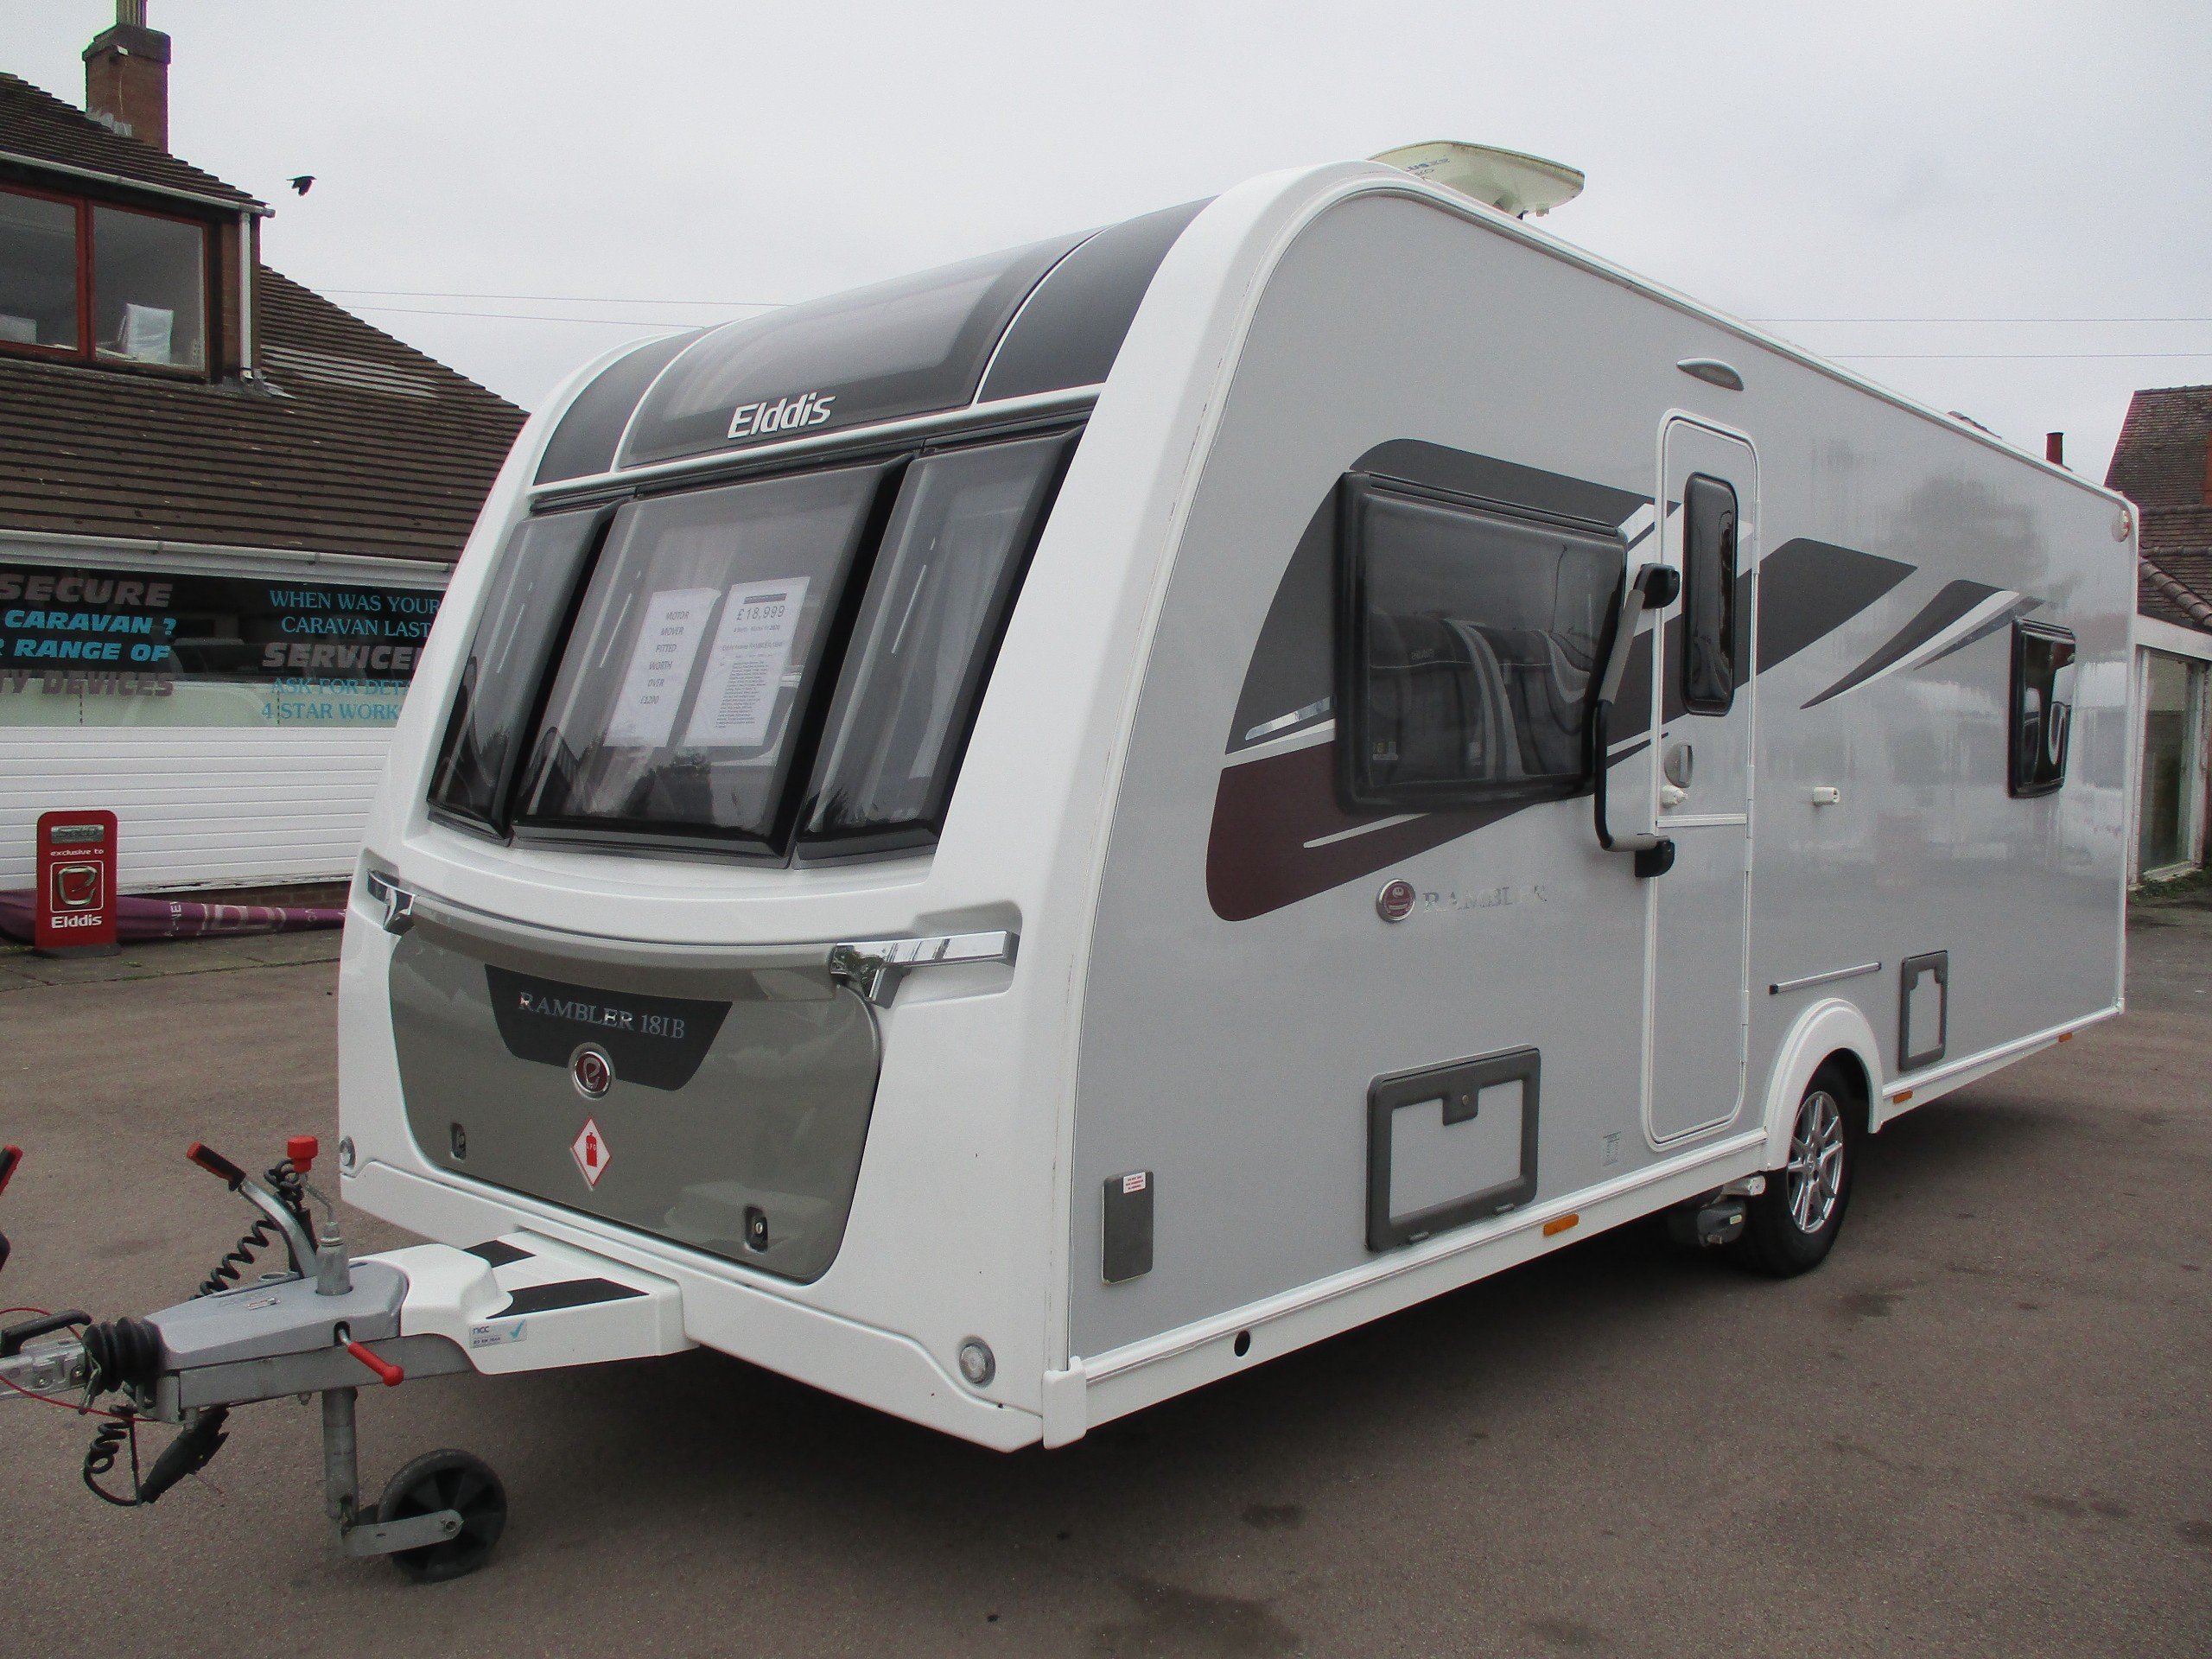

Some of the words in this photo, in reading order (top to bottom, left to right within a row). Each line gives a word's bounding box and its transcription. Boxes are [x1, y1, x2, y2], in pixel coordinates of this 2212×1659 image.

[728, 391, 836, 439] Elddis
[0, 574, 174, 607] SECURE
[270, 590, 331, 609] WHEN
[337, 594, 382, 611] WAS
[387, 596, 442, 614] YOUR
[665, 611, 690, 621] MOTOR
[736, 605, 785, 620] £18,999
[5, 609, 154, 634] CARAVAN
[162, 618, 177, 636] ?
[281, 616, 378, 636] CARAVAN
[385, 620, 433, 638] LAST
[660, 626, 684, 636] MOVER
[14, 639, 122, 660] RANGE
[130, 643, 172, 662] OF
[655, 644, 677, 653] FITTED
[649, 660, 673, 671] WORTH
[43, 670, 174, 697] DEVICES
[271, 677, 313, 694] ASK
[319, 677, 359, 696] FOR
[647, 678, 664, 688] OVER
[261, 702, 274, 719] 4
[280, 702, 333, 720] STAR
[51, 914, 103, 929] Elddis
[518, 991, 634, 1031] RAMBLER
